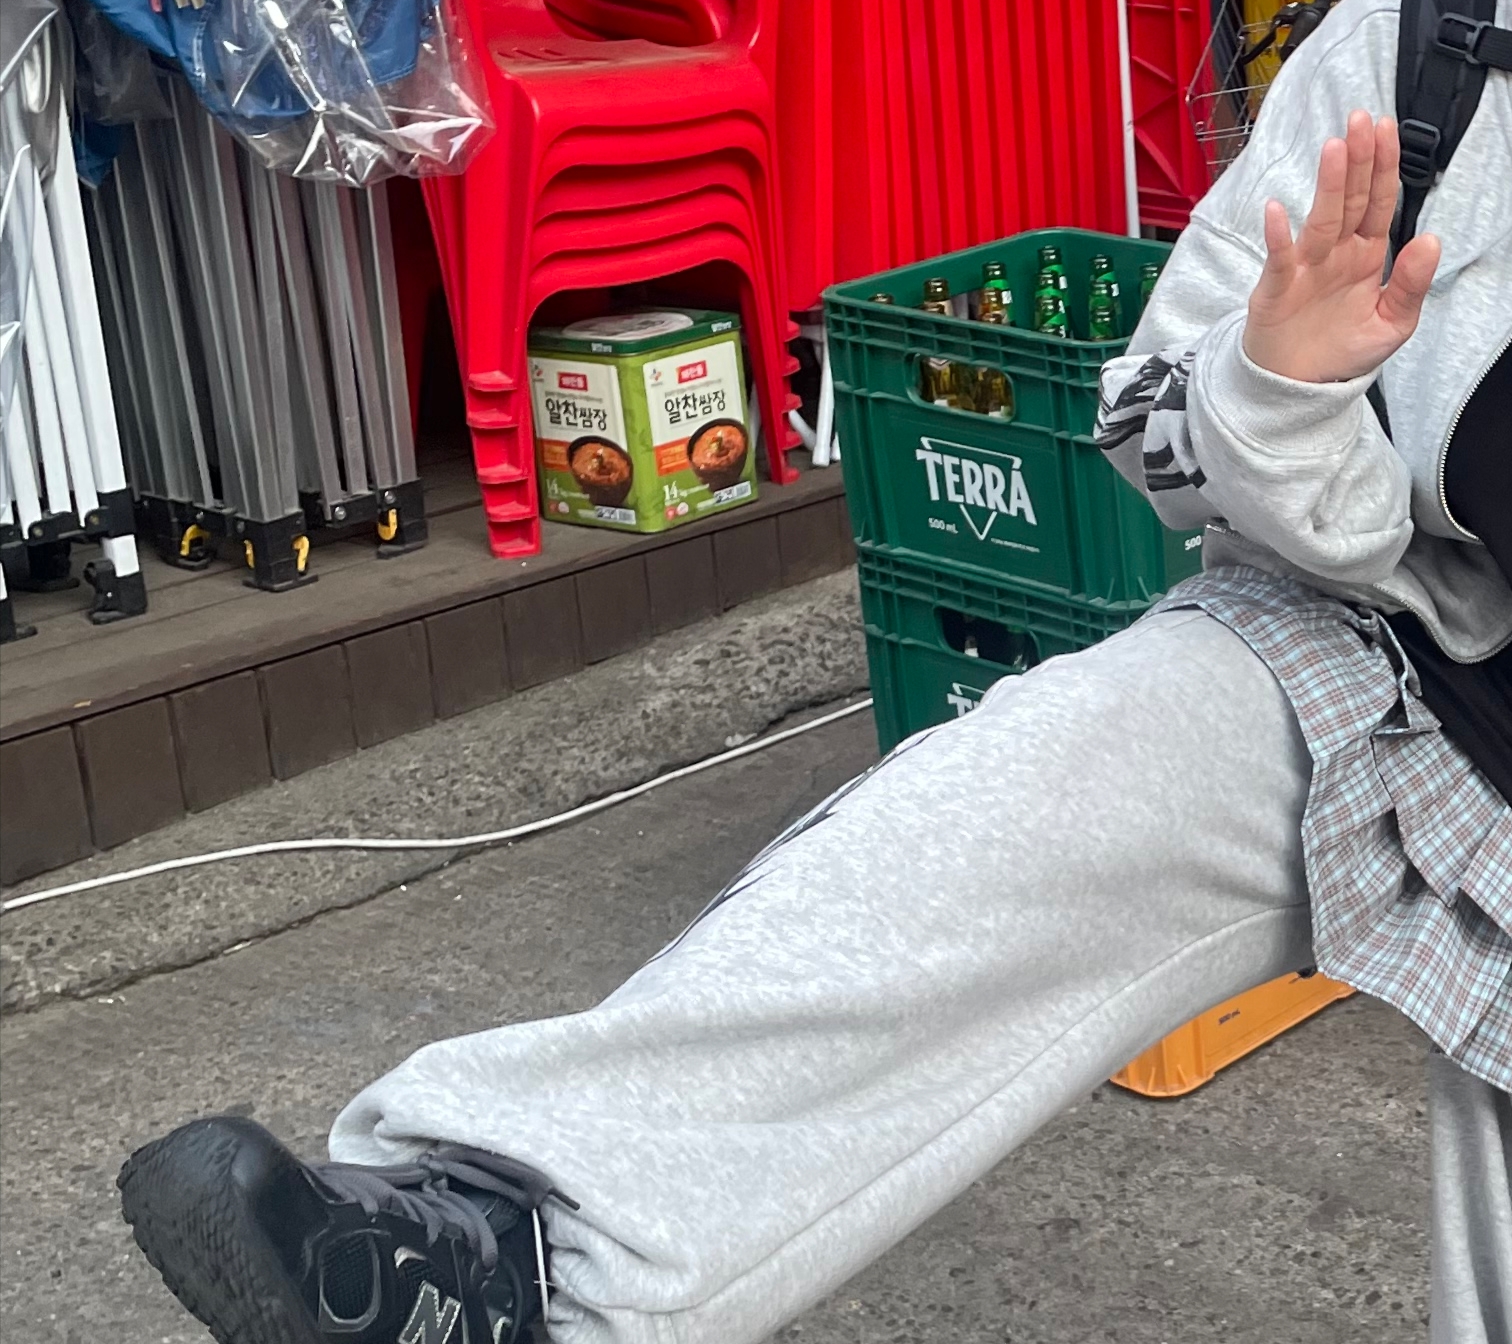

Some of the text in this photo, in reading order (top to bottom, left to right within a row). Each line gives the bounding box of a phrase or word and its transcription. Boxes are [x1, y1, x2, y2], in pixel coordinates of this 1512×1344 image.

[545, 398, 607, 431] 알찬쌈장
[664, 389, 726, 424] 알찬쌈장
[915, 448, 1038, 526] TERRA
[1184, 535, 1203, 551] 500
